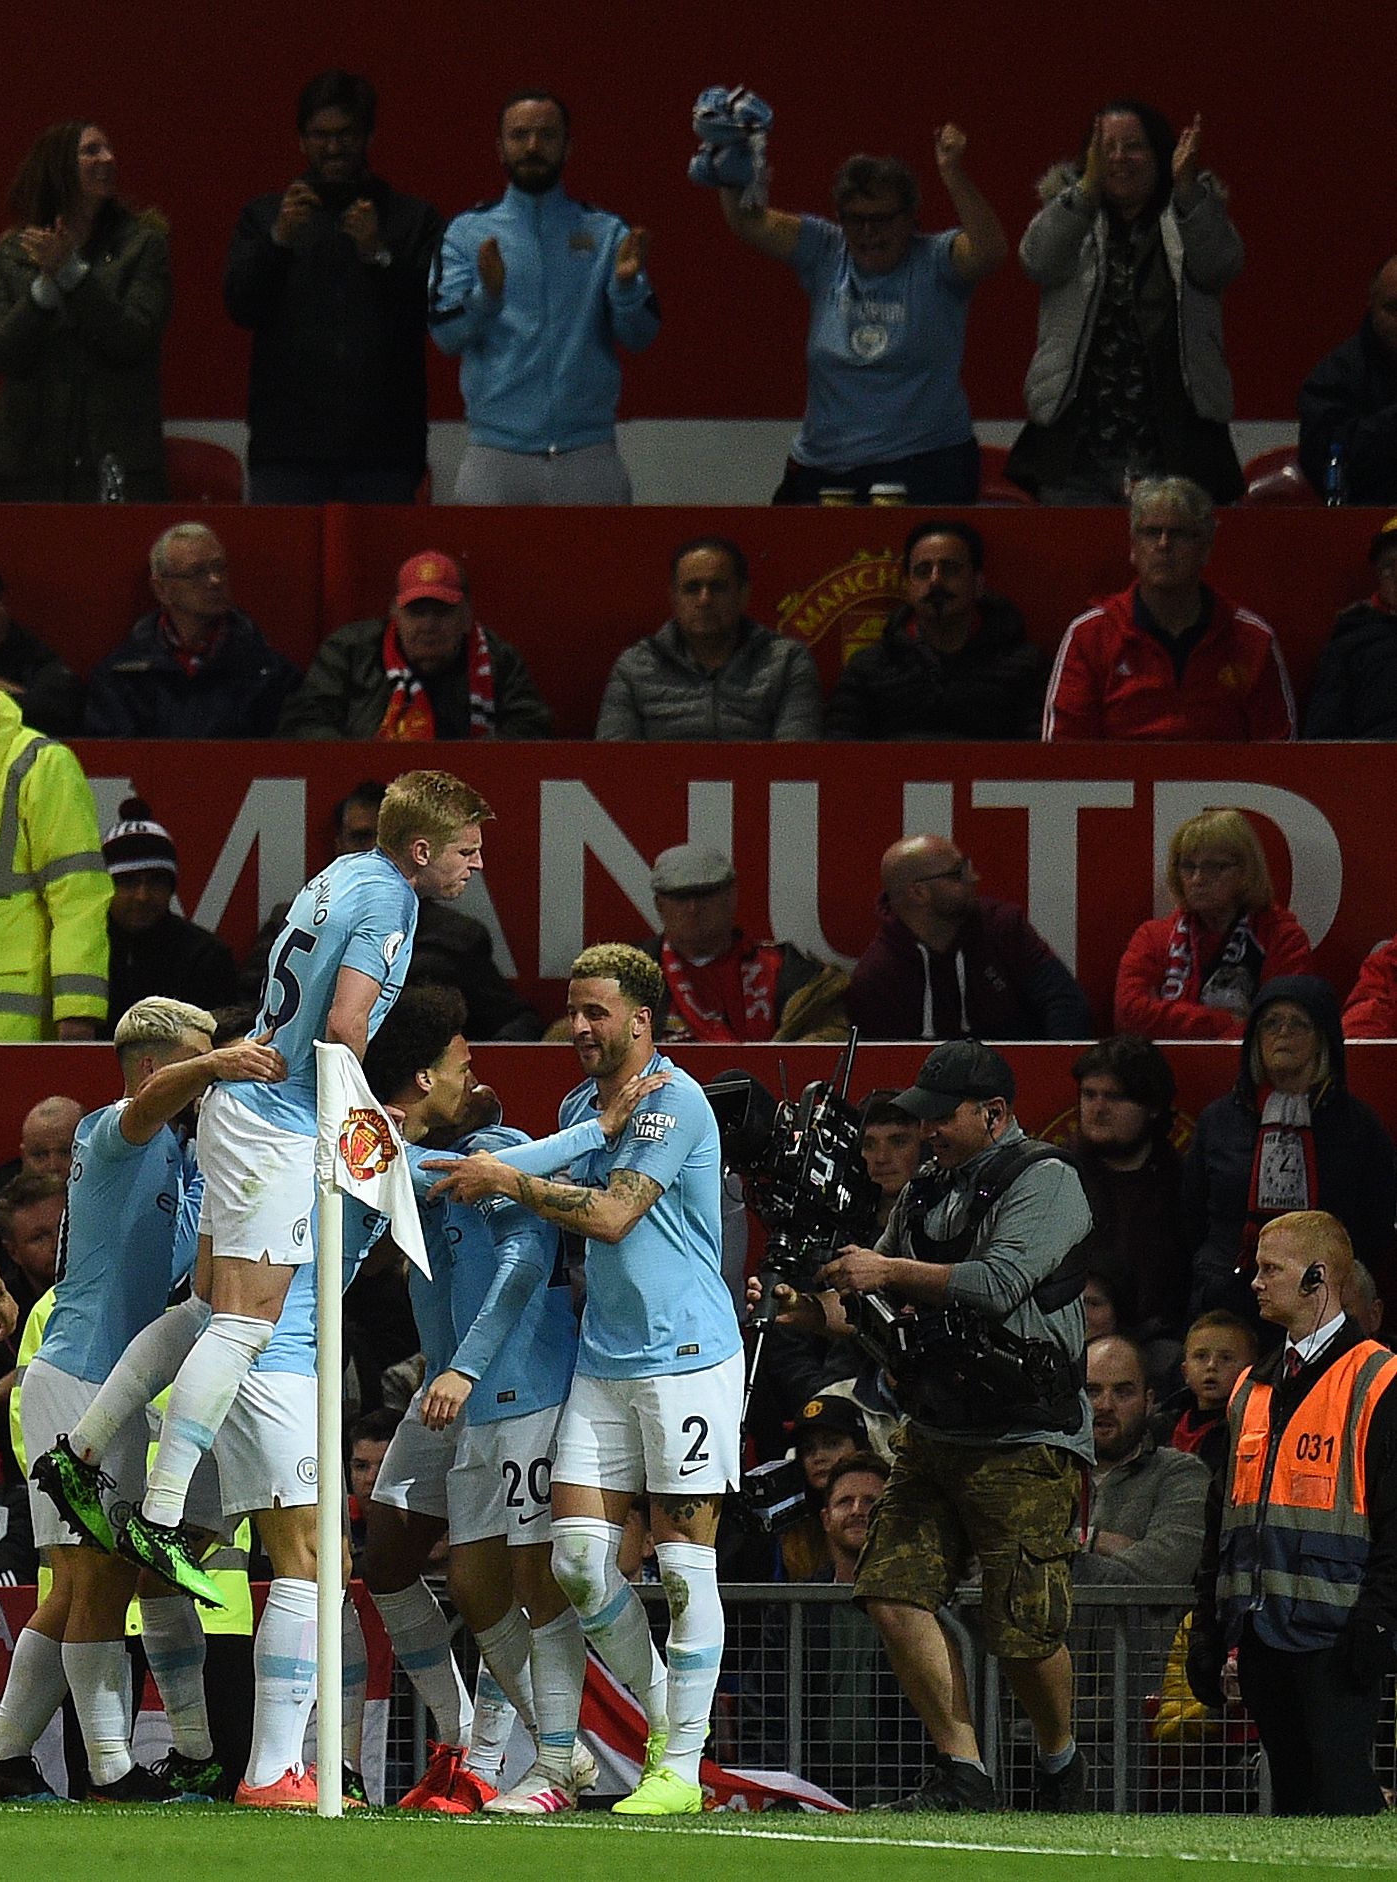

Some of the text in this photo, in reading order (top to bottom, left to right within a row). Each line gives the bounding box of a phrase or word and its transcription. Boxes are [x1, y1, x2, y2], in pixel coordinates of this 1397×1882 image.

[794, 567, 908, 634] MANCH
[635, 1124, 666, 1139] TIRE
[681, 1415, 710, 1462] 2
[1296, 1433, 1334, 1463] 031
[503, 1457, 552, 1508] 20
